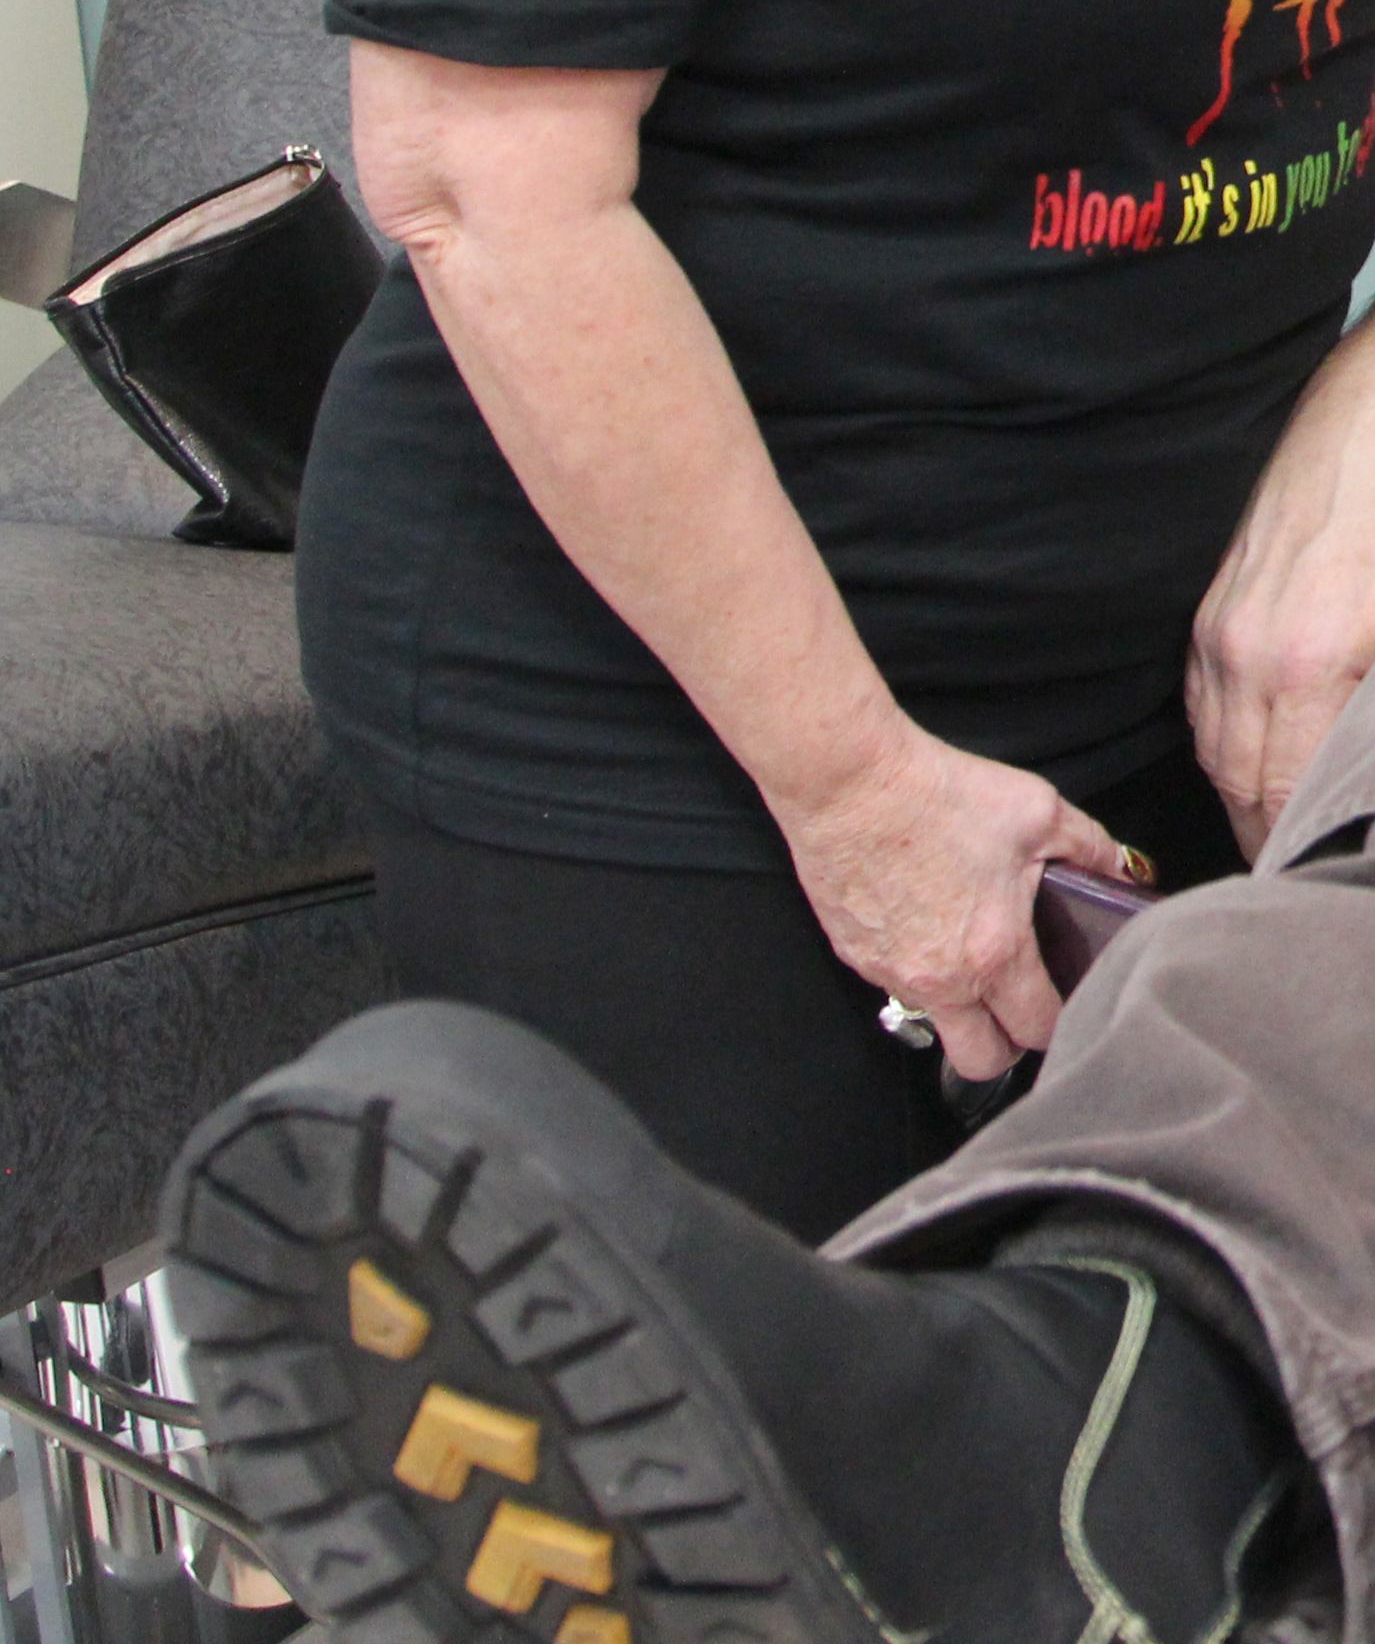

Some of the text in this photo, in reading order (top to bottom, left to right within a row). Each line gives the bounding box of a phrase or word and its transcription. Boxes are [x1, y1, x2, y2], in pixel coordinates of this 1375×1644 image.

[1174, 158, 1240, 245] it's
[1244, 160, 1278, 234] in
[1278, 150, 1331, 234] you
